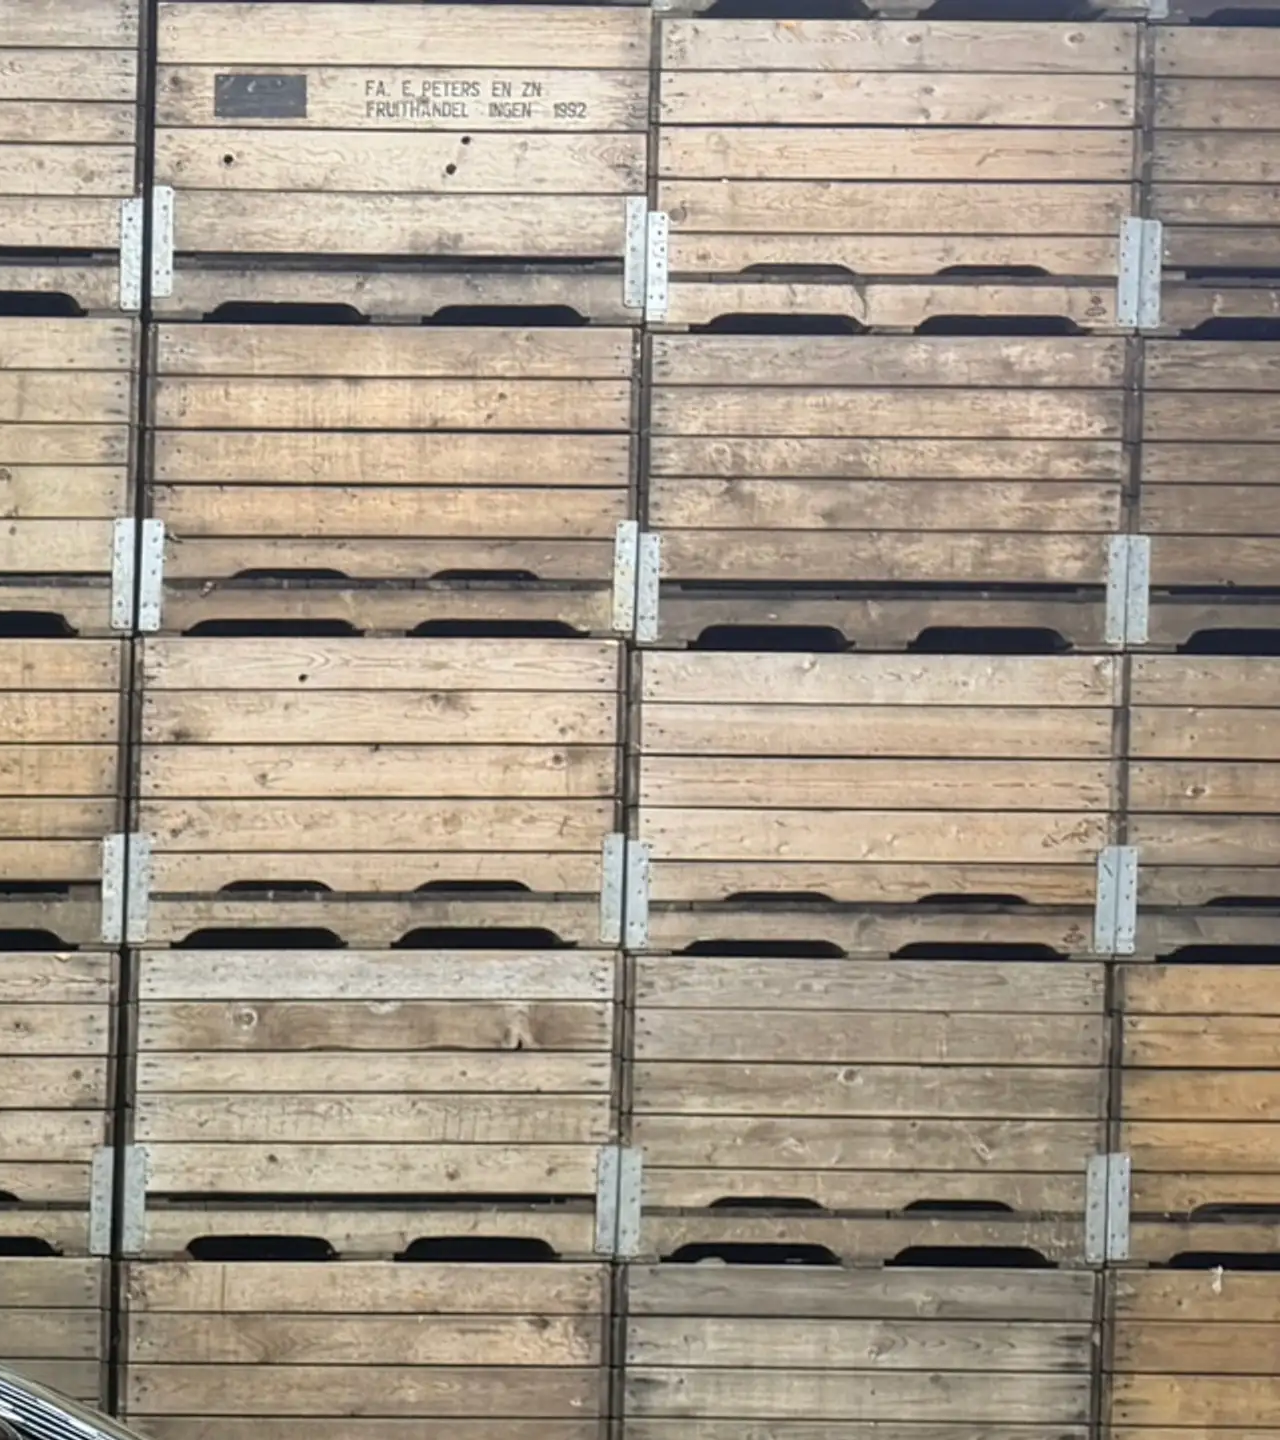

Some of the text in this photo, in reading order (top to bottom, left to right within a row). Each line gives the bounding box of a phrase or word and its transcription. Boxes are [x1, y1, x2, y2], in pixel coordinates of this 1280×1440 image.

[421, 80, 480, 98] PETERS
[491, 80, 512, 98] EN
[521, 81, 542, 98] ZN
[365, 101, 588, 119] FRUITHANDEL INGEN 1992
